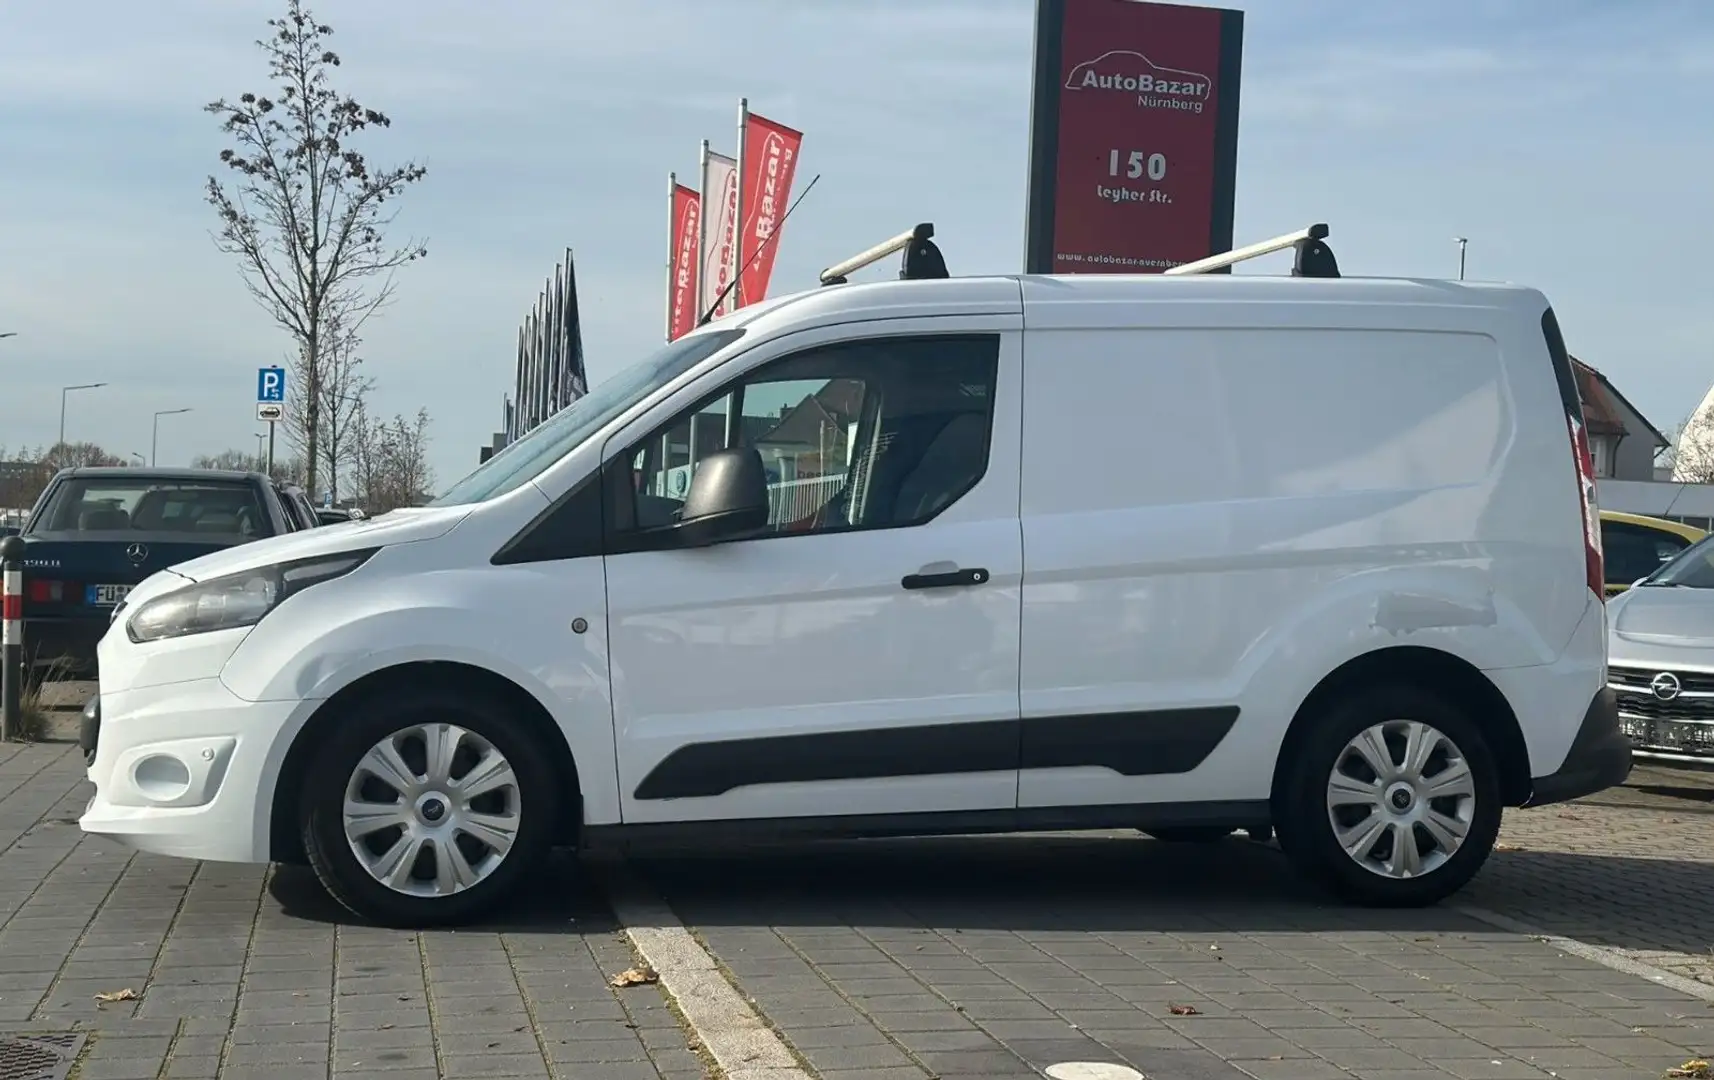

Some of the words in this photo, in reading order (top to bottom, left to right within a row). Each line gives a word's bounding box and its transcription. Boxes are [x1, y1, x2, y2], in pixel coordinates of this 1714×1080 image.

[1081, 69, 1206, 97] AutoBazar
[1137, 95, 1204, 114] Nürnberg
[1109, 149, 1167, 181] 150
[1096, 184, 1146, 203] Leyher
[1148, 188, 1173, 204] Str.
[263, 371, 279, 398] P
